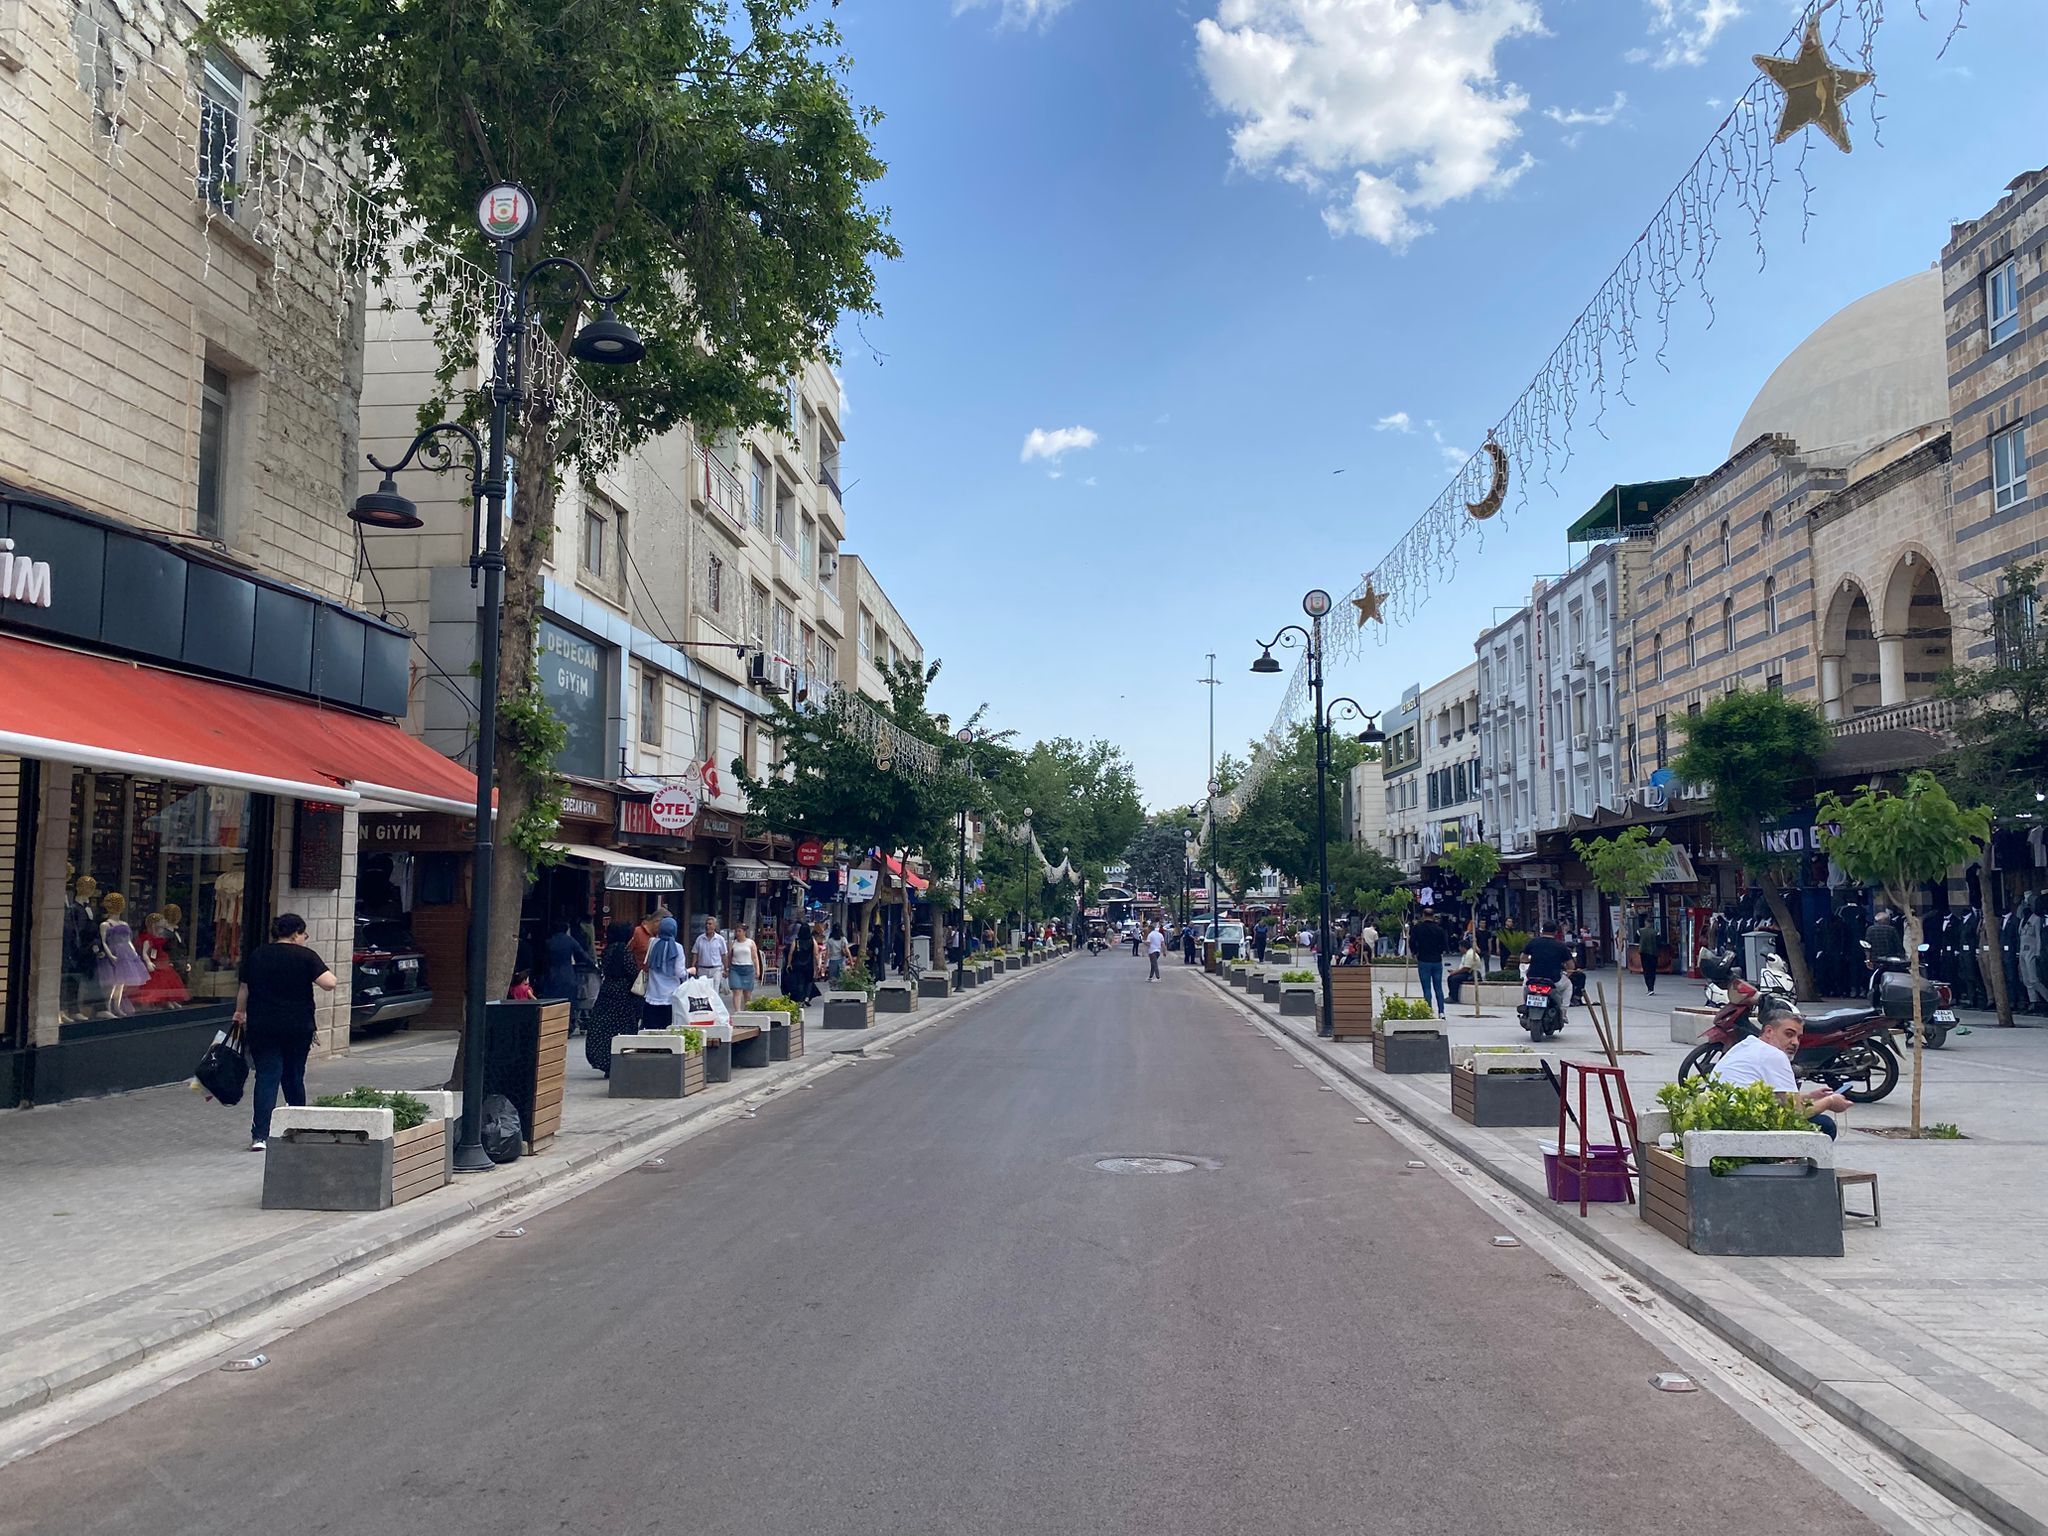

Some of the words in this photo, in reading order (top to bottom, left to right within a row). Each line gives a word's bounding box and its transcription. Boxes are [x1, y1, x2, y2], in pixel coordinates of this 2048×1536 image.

[547, 631, 598, 671] DEDECAN
[558, 667, 588, 697] GİYİM
[654, 785, 678, 803] KERVAN
[560, 797, 583, 813] EDECAN
[652, 802, 694, 816] OTEL
[376, 825, 421, 840] GİYİM
[619, 871, 654, 888] DEDECAN
[654, 874, 674, 889] GİYİM
